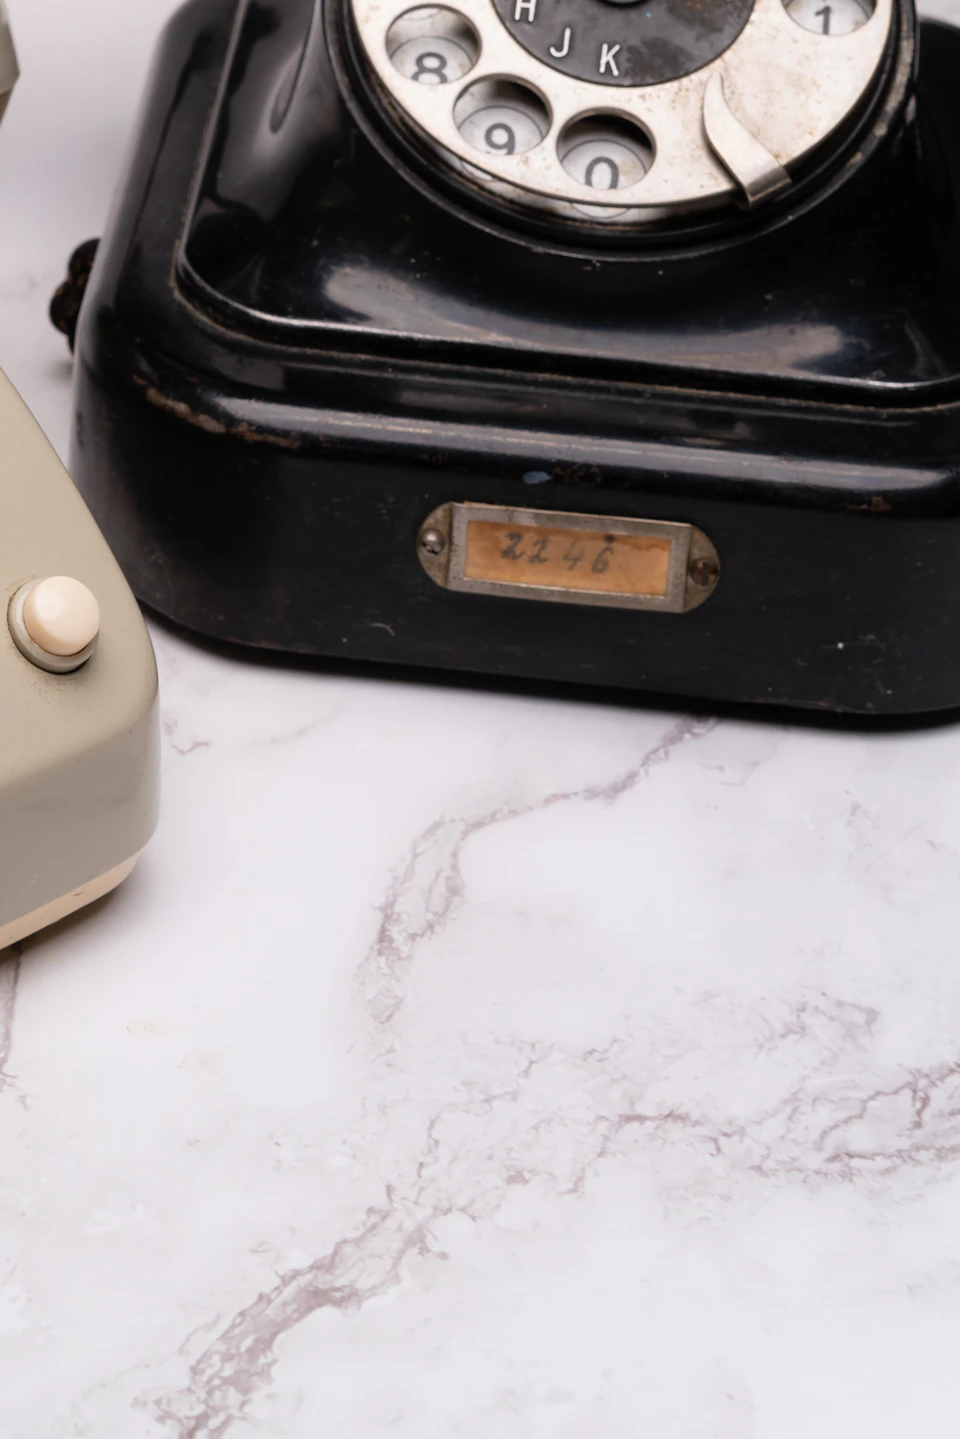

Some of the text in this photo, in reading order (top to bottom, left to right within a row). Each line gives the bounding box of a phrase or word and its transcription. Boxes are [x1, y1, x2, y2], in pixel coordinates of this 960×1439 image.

[815, 5, 831, 35] 1
[549, 27, 571, 58] J
[412, 52, 448, 84] 8
[599, 43, 621, 76] K
[484, 122, 516, 155] 9
[585, 156, 619, 190] 0
